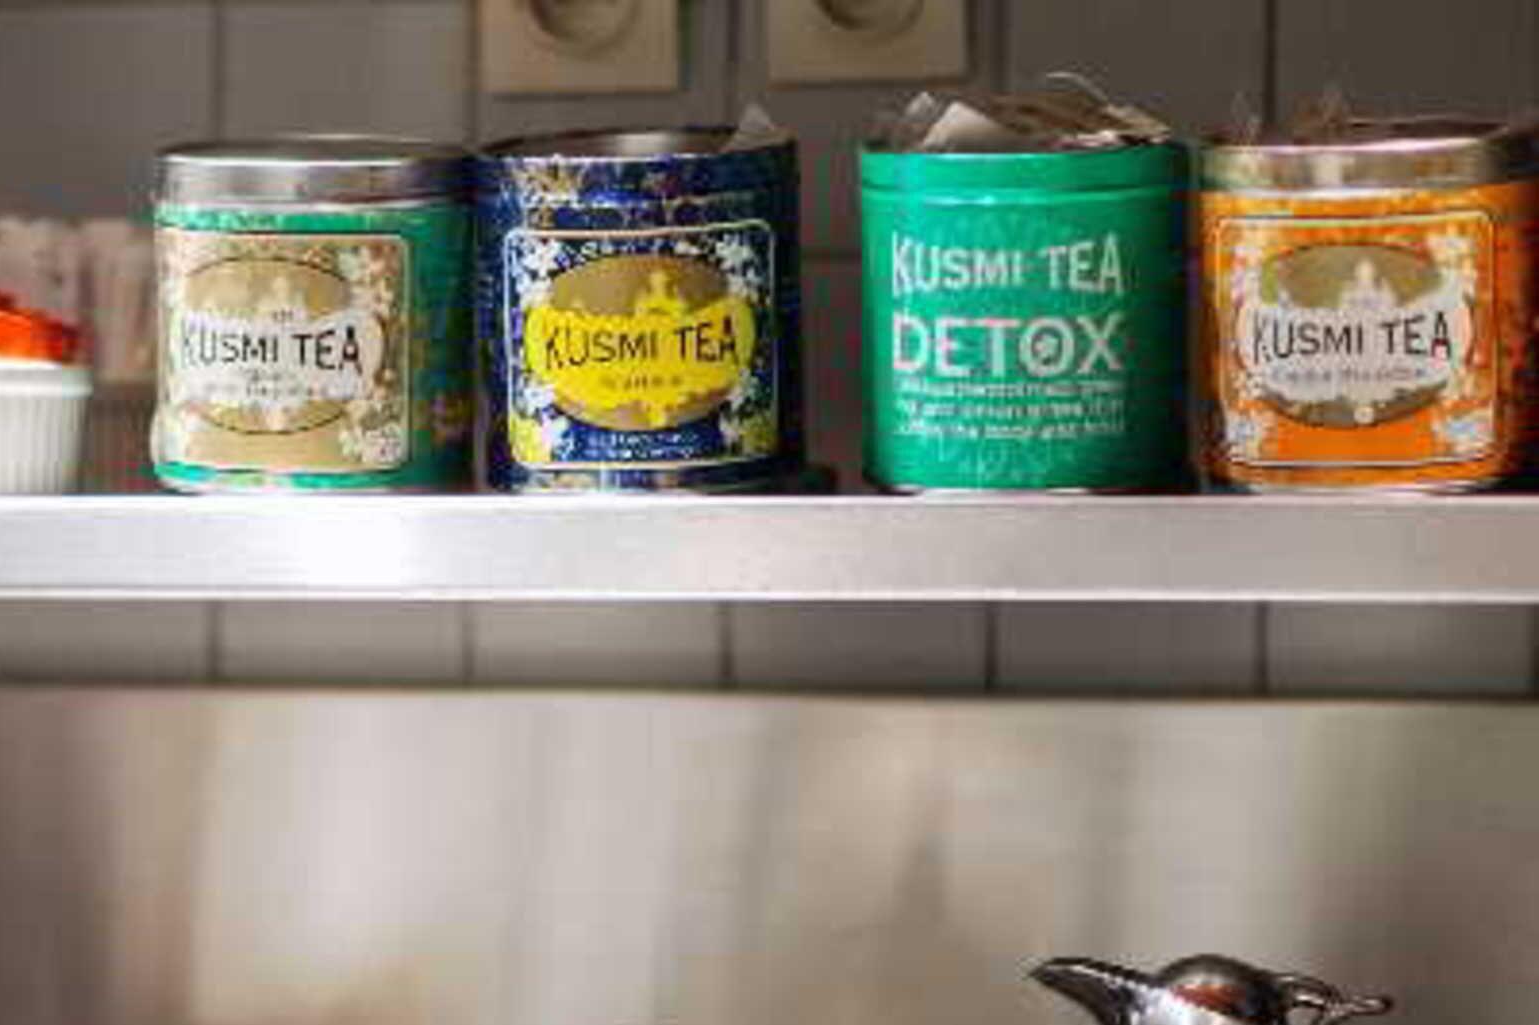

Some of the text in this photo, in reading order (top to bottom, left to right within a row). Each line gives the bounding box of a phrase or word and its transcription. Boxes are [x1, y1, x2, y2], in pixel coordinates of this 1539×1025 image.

[892, 231, 1124, 297] KUSMI TEA
[182, 318, 362, 373] KUSMI TEA
[545, 315, 739, 371] KUSMI TEA
[892, 312, 1124, 377] DETOX
[1253, 311, 1452, 365] KUSMI TEA
